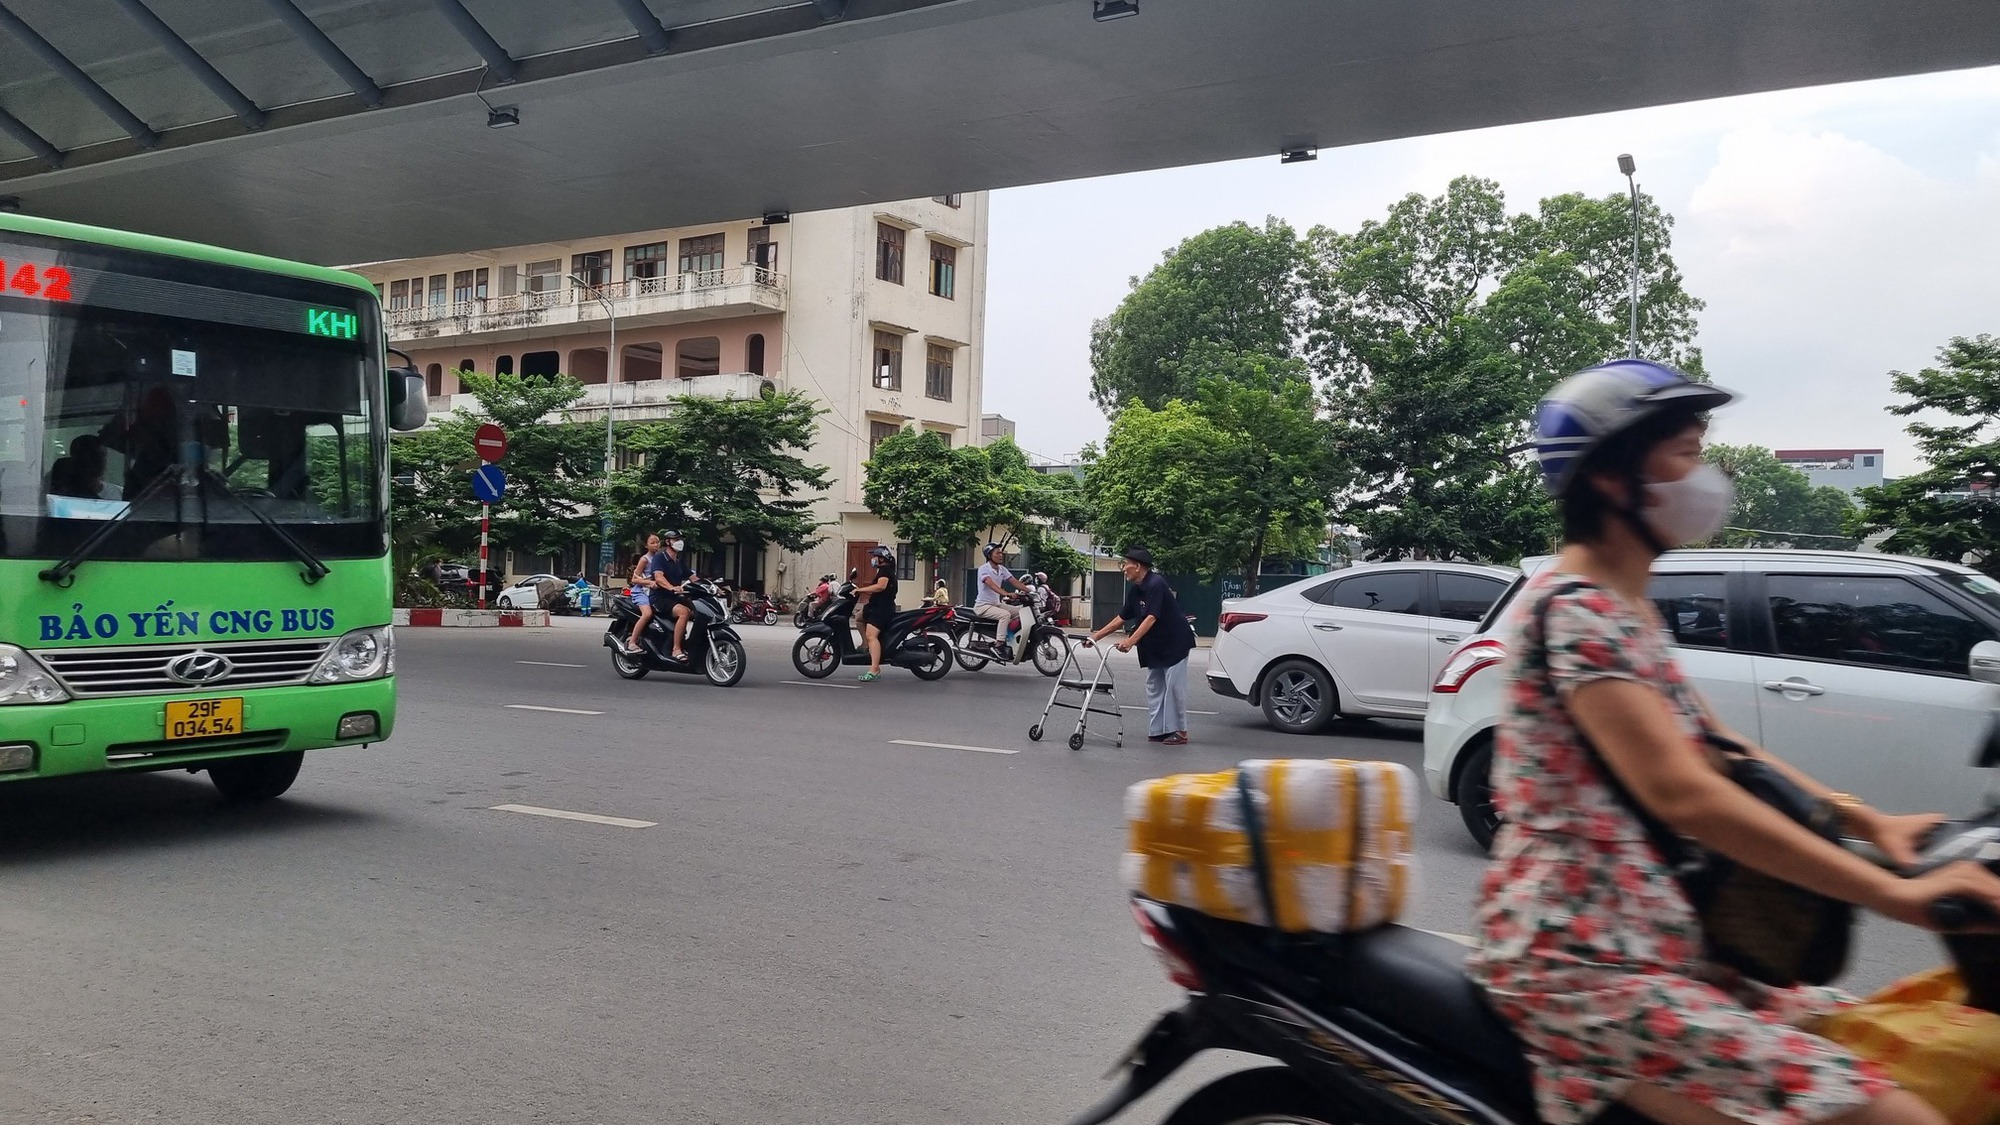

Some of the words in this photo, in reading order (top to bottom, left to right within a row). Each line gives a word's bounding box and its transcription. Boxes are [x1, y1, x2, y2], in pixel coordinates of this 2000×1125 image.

[38, 602, 119, 641] BẢO
[127, 599, 199, 637] YẾN
[209, 610, 273, 634] CNG
[280, 608, 335, 632] BUS
[188, 701, 222, 718] 29F
[174, 717, 234, 737] 034.54
